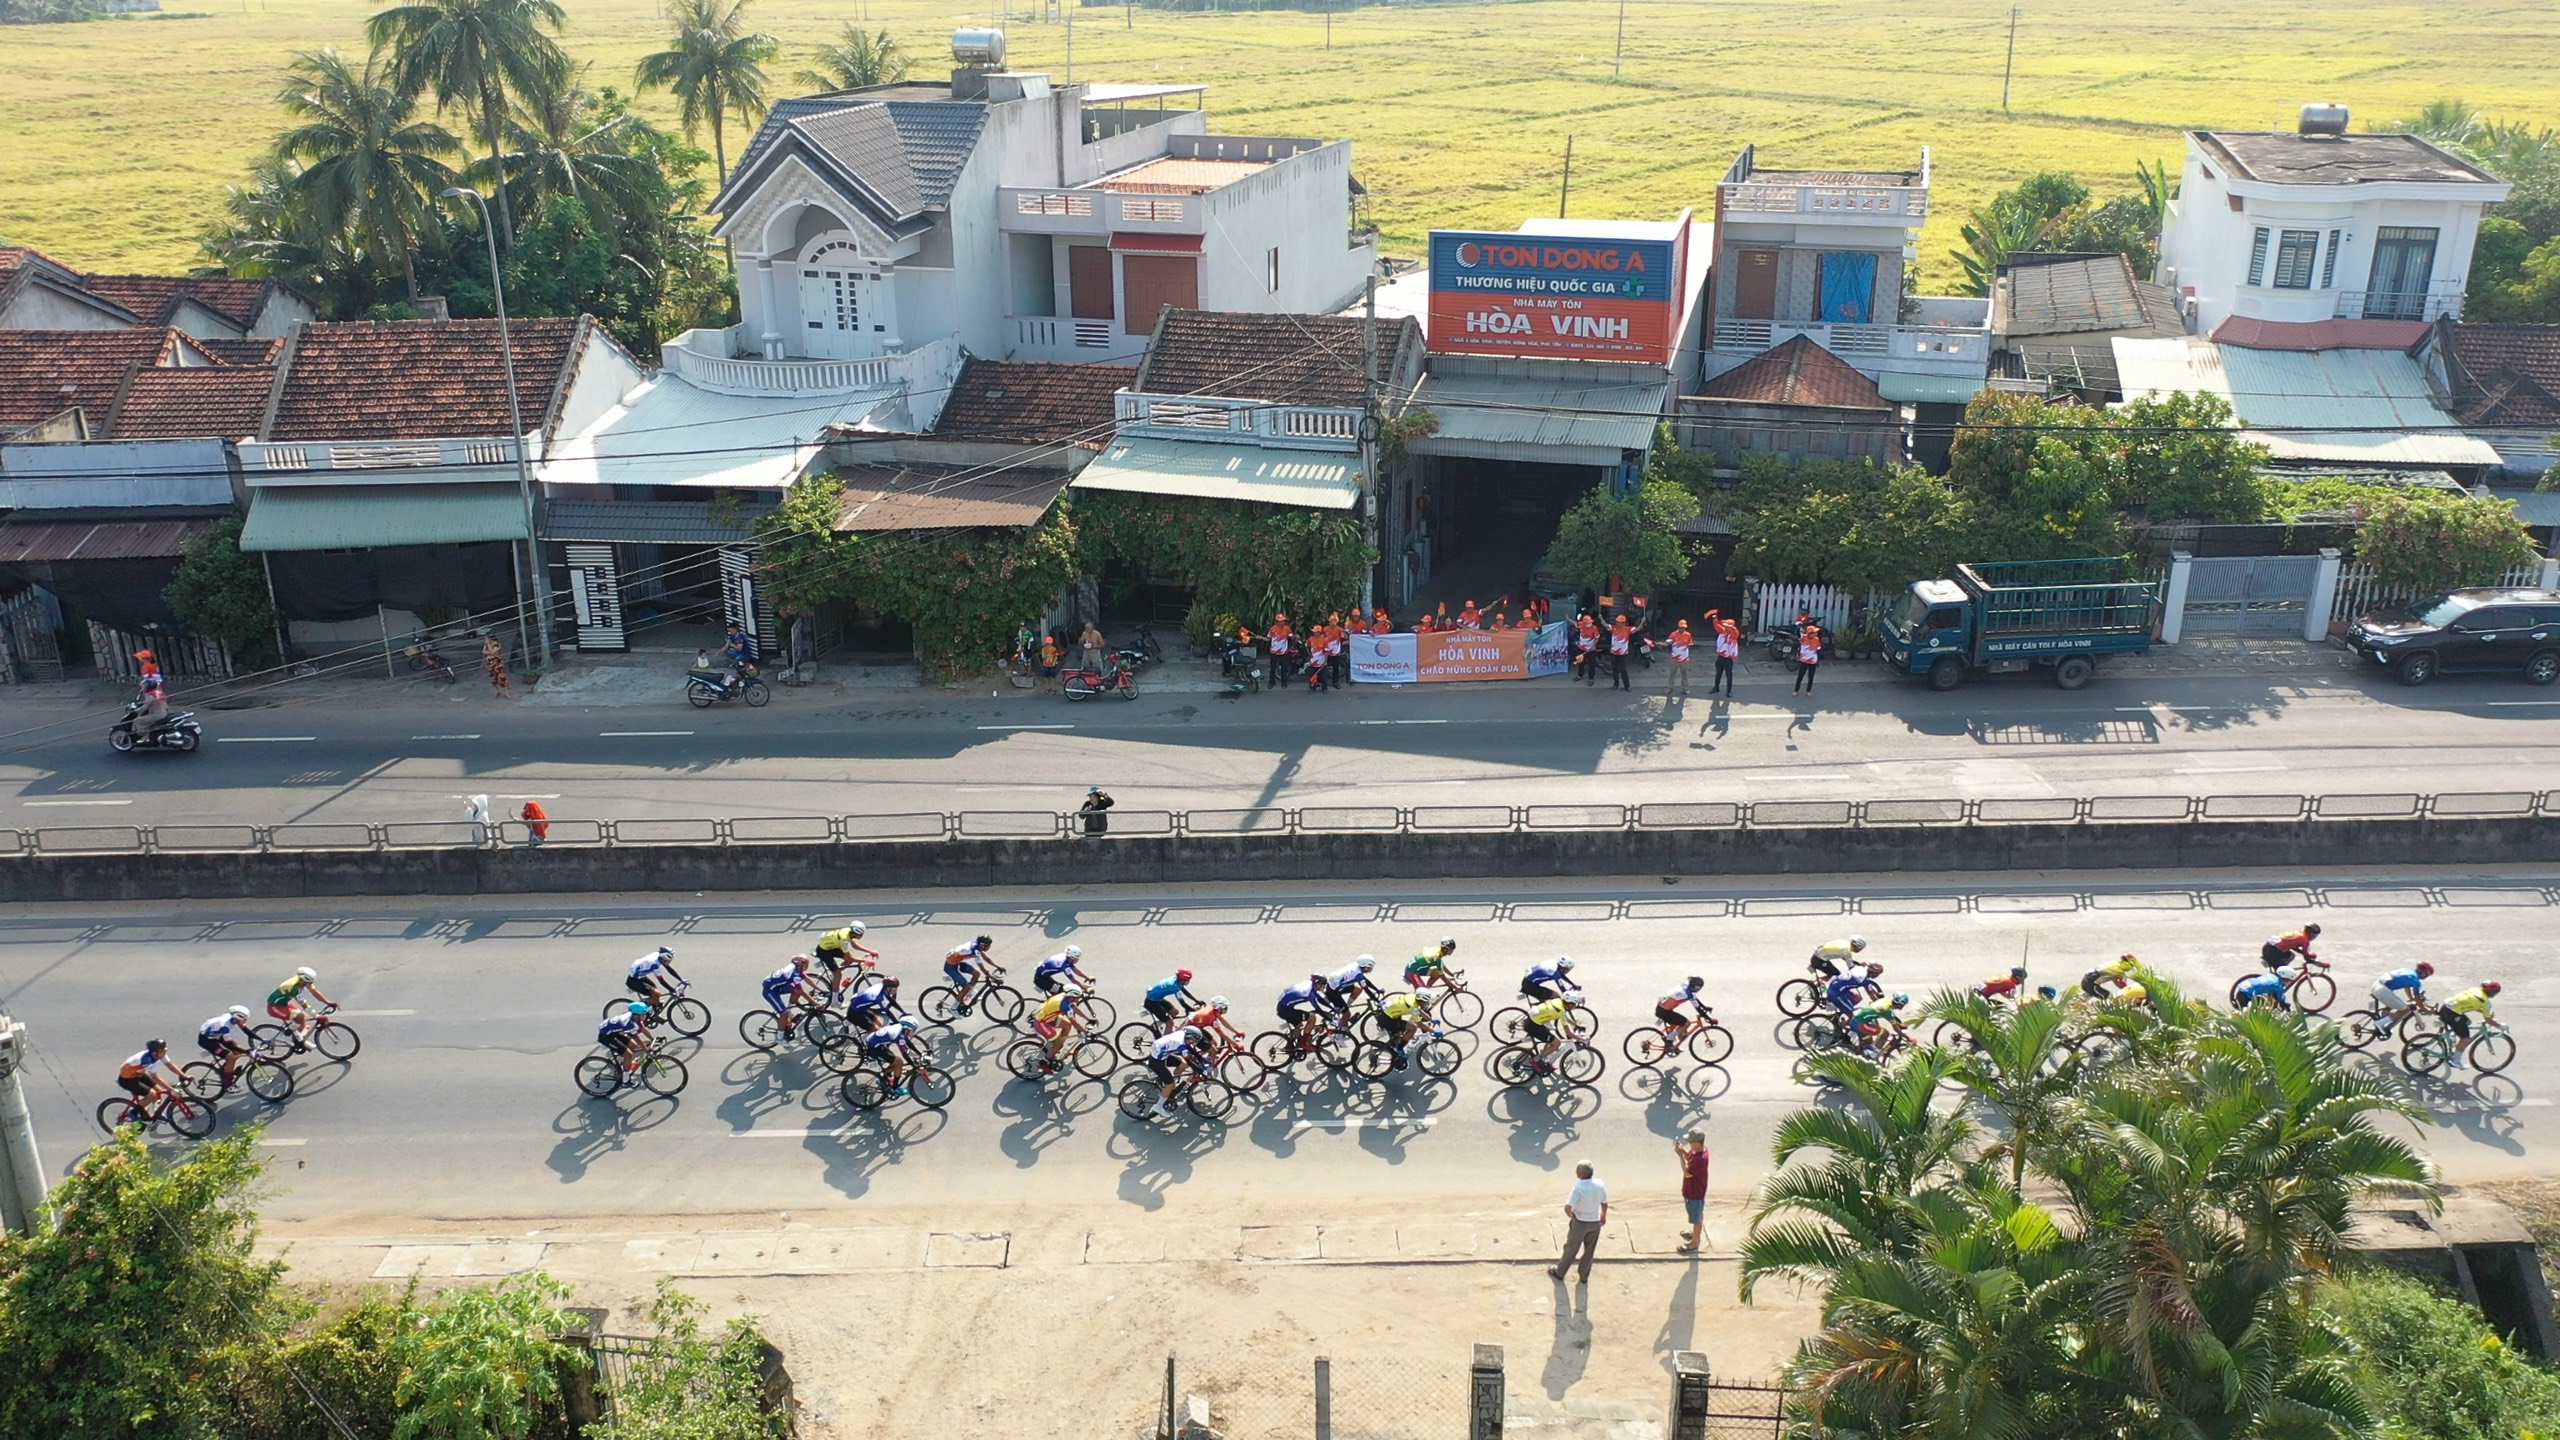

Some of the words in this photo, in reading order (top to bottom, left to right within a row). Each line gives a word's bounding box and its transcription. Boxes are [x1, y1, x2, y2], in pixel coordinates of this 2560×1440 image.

[1624, 251, 1646, 272] A
[1455, 276, 1512, 289] THƯƠNG
[1516, 276, 1546, 292] HIỆU
[1550, 278, 1588, 293] QUỐC
[1592, 282, 1616, 293] GIA
[1513, 298, 1535, 307] NHÀ
[1537, 298, 1558, 308] MÁY
[1561, 299, 1582, 309] TÔN
[1467, 305, 1533, 335] HÒA
[1551, 315, 1628, 339] VINH
[1462, 634, 1476, 642] MÁY
[1988, 642, 2003, 651] NHÀ
[2004, 642, 2021, 651] MÁY
[2022, 641, 2037, 650] CÁN
[2058, 639, 2073, 648] HÒA
[2074, 639, 2092, 647] VINH
[1439, 645, 1464, 660] HÒA
[1469, 648, 1500, 660] VINH
[1420, 665, 1444, 675] CHÀO
[1446, 664, 1472, 674] MỪNG
[1474, 664, 1498, 673] ĐOÀN
[1501, 664, 1519, 673] ĐUA
